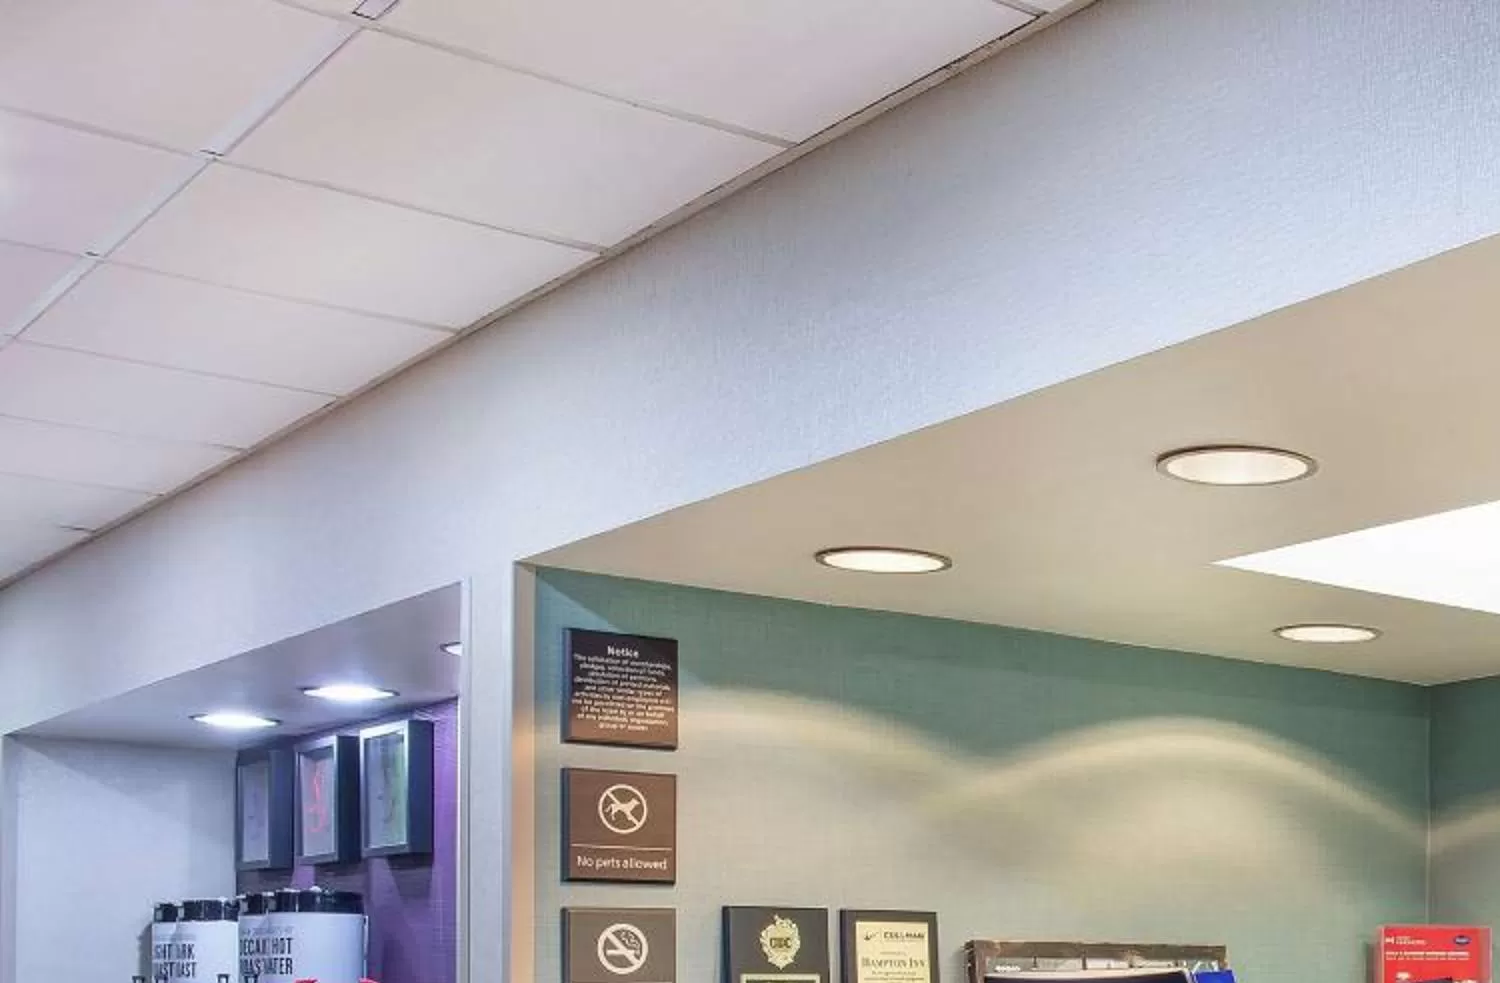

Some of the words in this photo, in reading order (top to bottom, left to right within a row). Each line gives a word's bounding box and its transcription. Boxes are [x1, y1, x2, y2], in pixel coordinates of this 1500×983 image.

[607, 645, 640, 659] Notice
[577, 856, 594, 868] No
[595, 857, 620, 870] pets
[621, 857, 668, 870] allowed
